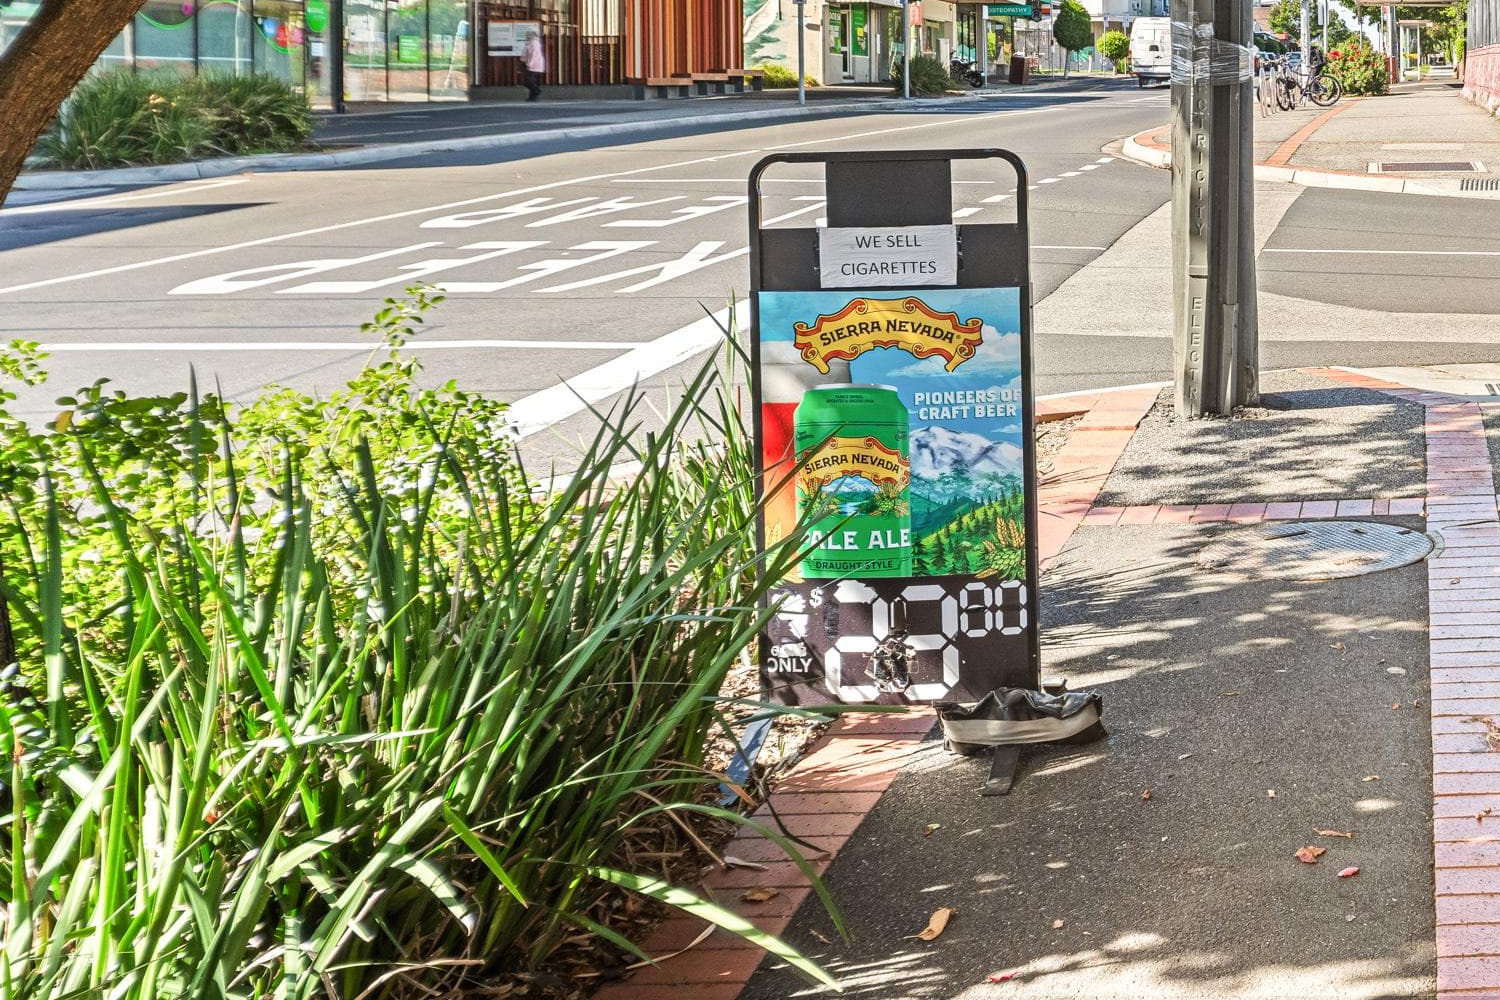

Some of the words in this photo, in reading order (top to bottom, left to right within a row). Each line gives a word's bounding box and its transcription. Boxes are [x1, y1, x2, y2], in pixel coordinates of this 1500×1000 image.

[855, 235, 882, 248] WE
[886, 234, 922, 248] SELL
[841, 261, 937, 276] CIGARETTES
[820, 322, 881, 346] SIERRA
[885, 318, 955, 343] NEVADA
[914, 390, 996, 406] PIONEERS
[1000, 390, 1021, 402] OF
[918, 407, 969, 420] CRAFT
[974, 405, 1017, 418] BEER
[805, 454, 848, 475] SIERRA
[851, 453, 900, 474] NEVADA
[803, 530, 859, 550] ALE
[868, 528, 911, 550] ALE
